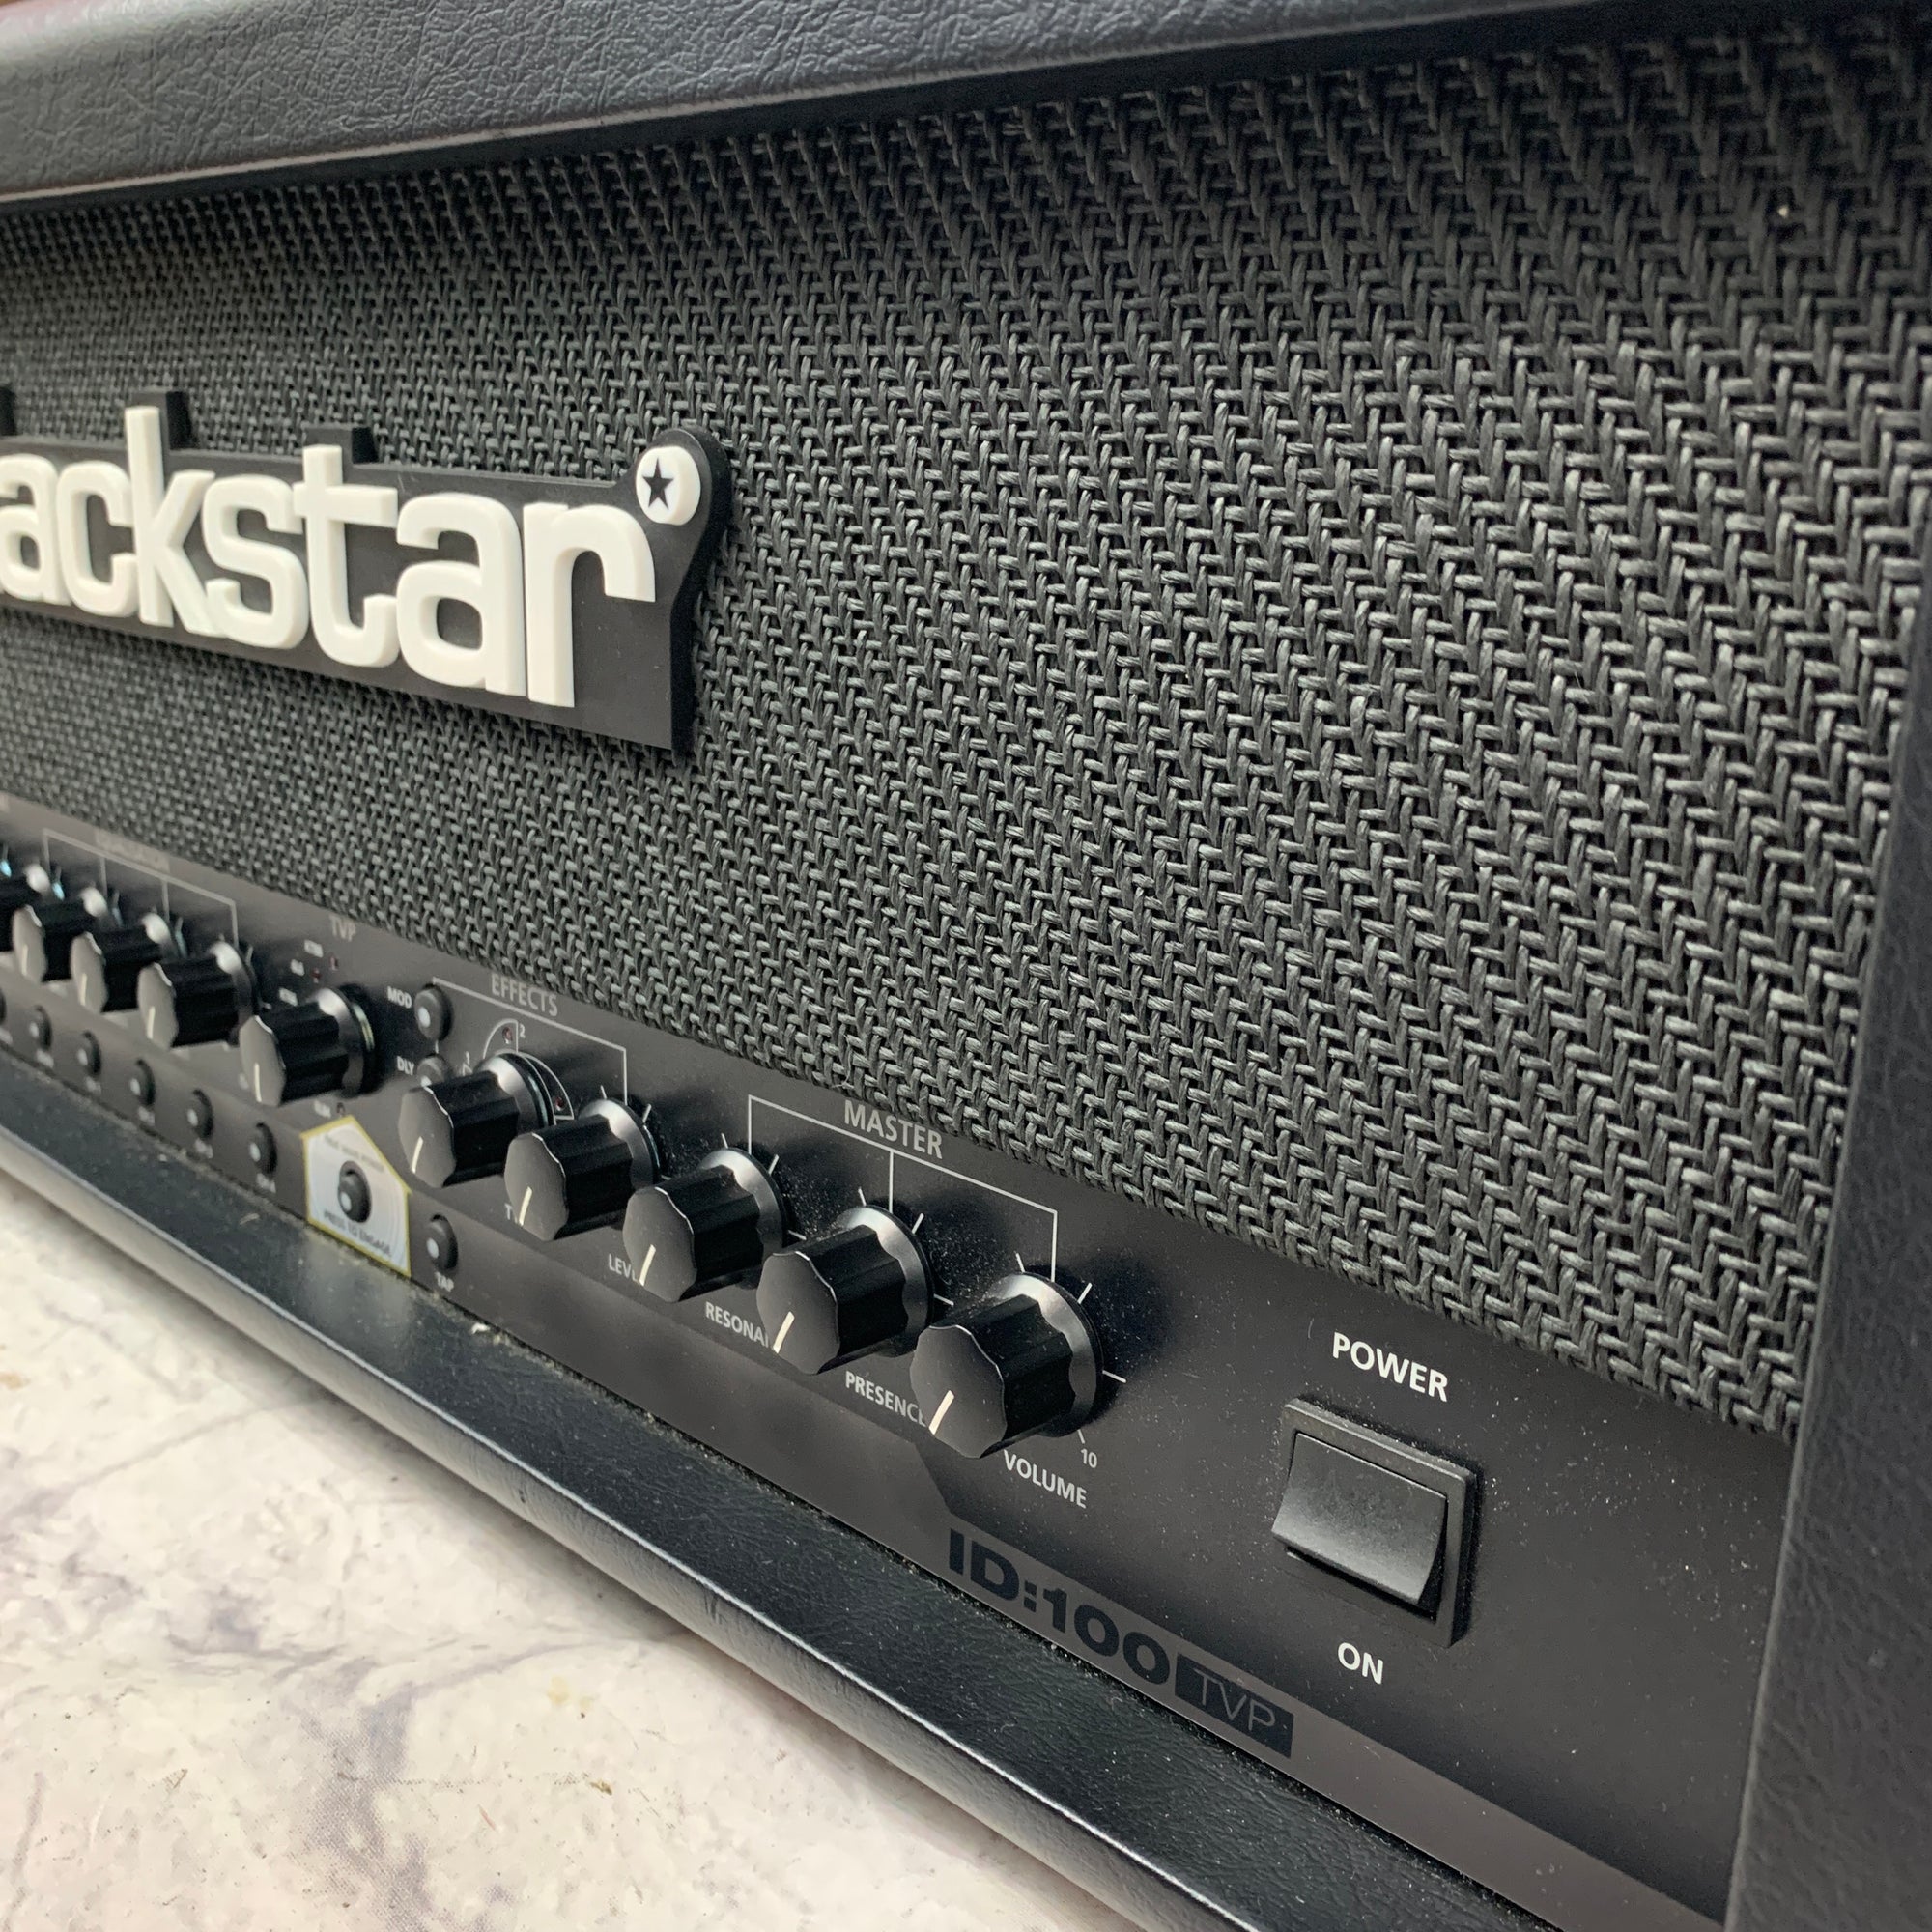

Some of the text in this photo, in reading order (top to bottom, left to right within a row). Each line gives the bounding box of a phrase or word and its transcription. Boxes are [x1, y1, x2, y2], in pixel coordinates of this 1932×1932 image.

[387, 986, 412, 1009] MOD
[491, 973, 558, 1017] EFFECTS
[519, 1023, 526, 1039] 2
[396, 1055, 415, 1076] DLY
[844, 1099, 943, 1160] MASTER
[1332, 1331, 1449, 1402] POWER
[1003, 1449, 1088, 1509] VOLUME
[1080, 1448, 1098, 1469] 10
[949, 1527, 1276, 1732] ID:100 TVP
[1337, 1641, 1384, 1685] ON
